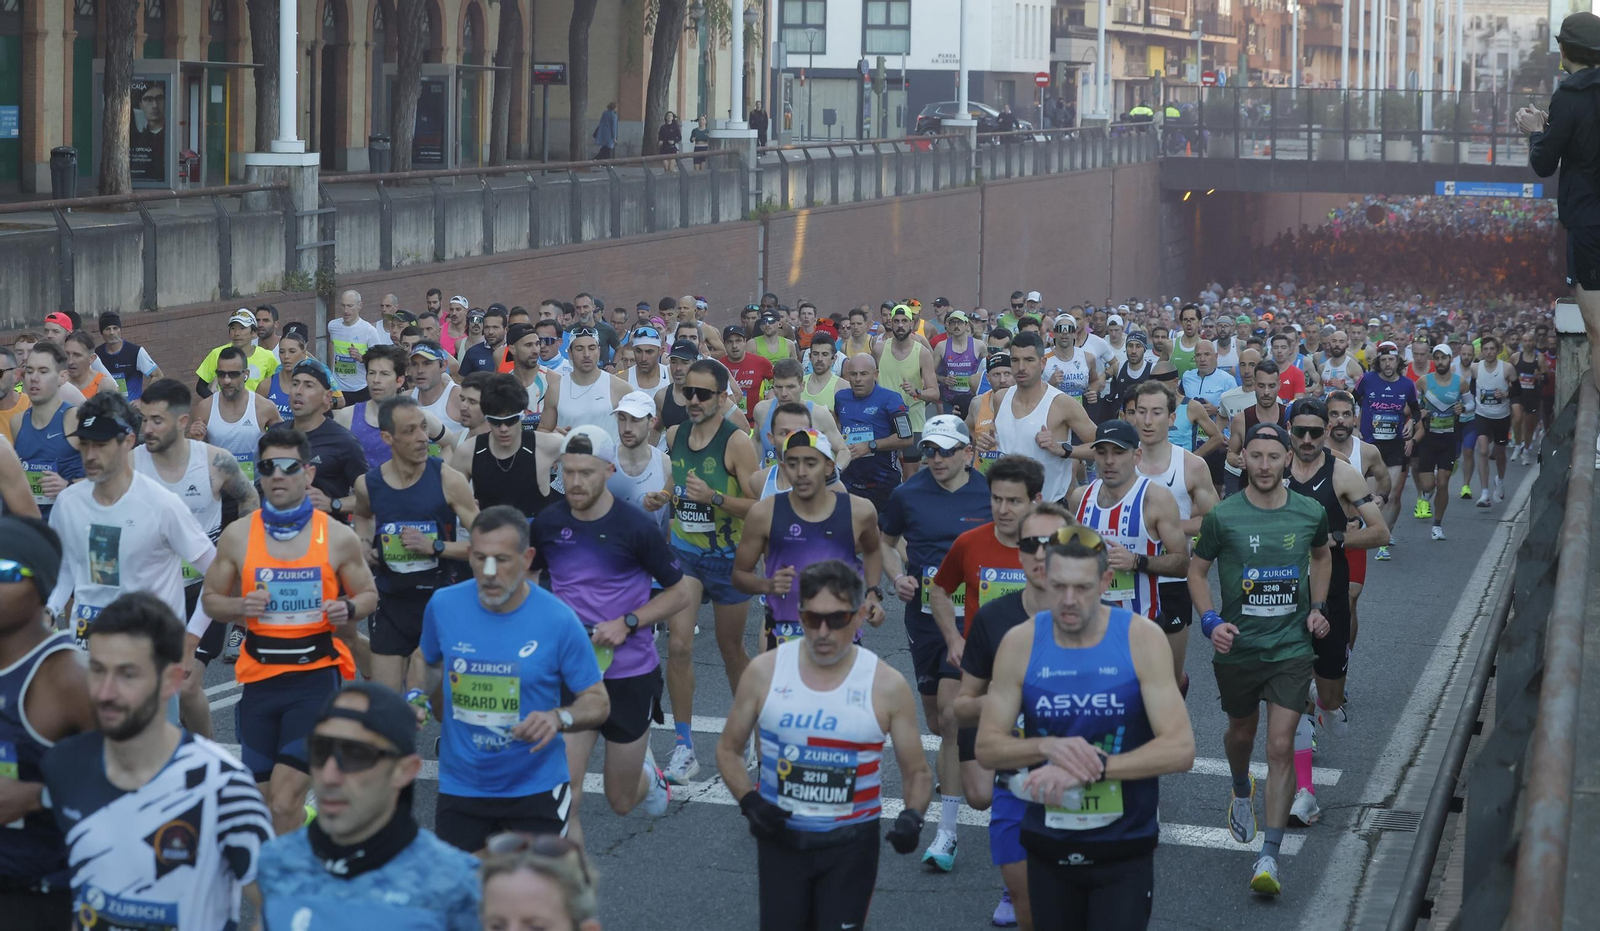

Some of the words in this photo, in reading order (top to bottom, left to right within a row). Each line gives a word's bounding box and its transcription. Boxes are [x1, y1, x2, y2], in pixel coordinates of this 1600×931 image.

[277, 570, 314, 580] ZURICH
[1000, 572, 1027, 580] ZURIC
[1262, 569, 1292, 578] ZURICH
[282, 597, 321, 611] GUILLE
[1249, 593, 1292, 605] QUENTIN
[470, 662, 512, 674] ZURICH
[472, 682, 493, 692] 2193
[452, 692, 497, 710] GERARD
[502, 698, 518, 710] VB
[1036, 693, 1125, 710] ASVEL
[1036, 708, 1126, 718] TRIATHLON
[779, 708, 838, 731] aula
[804, 750, 849, 763] ZURICH
[803, 771, 828, 783] 3218
[784, 781, 848, 802] PENKIUM
[108, 900, 166, 920] ZURICH
